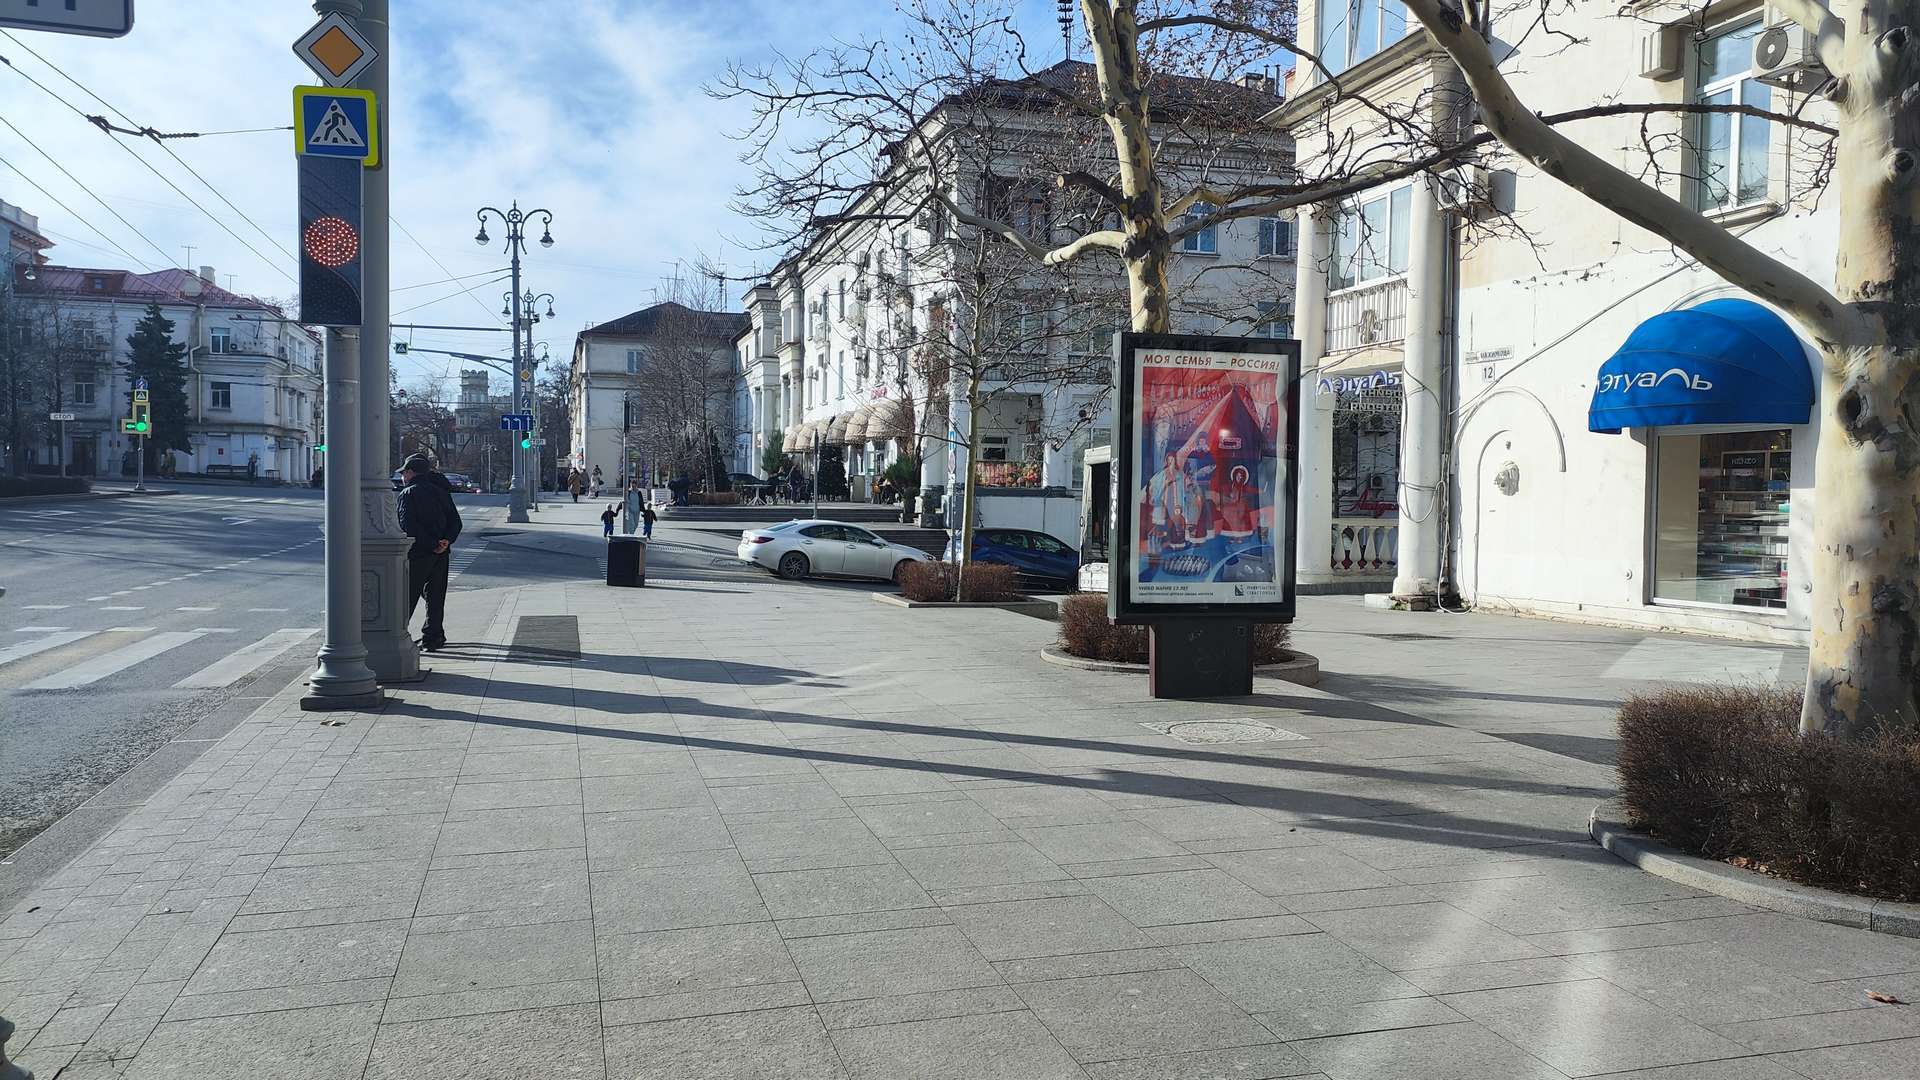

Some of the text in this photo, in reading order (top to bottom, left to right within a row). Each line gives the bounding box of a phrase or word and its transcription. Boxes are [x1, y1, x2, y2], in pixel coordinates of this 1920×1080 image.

[1143, 354, 1170, 364] МОЯ
[1174, 355, 1212, 366] СЕМЬЯ
[1230, 358, 1281, 370] РОССИЯ!
[1483, 367, 1493, 379] 12
[1596, 368, 1713, 393] 'Этуаль
